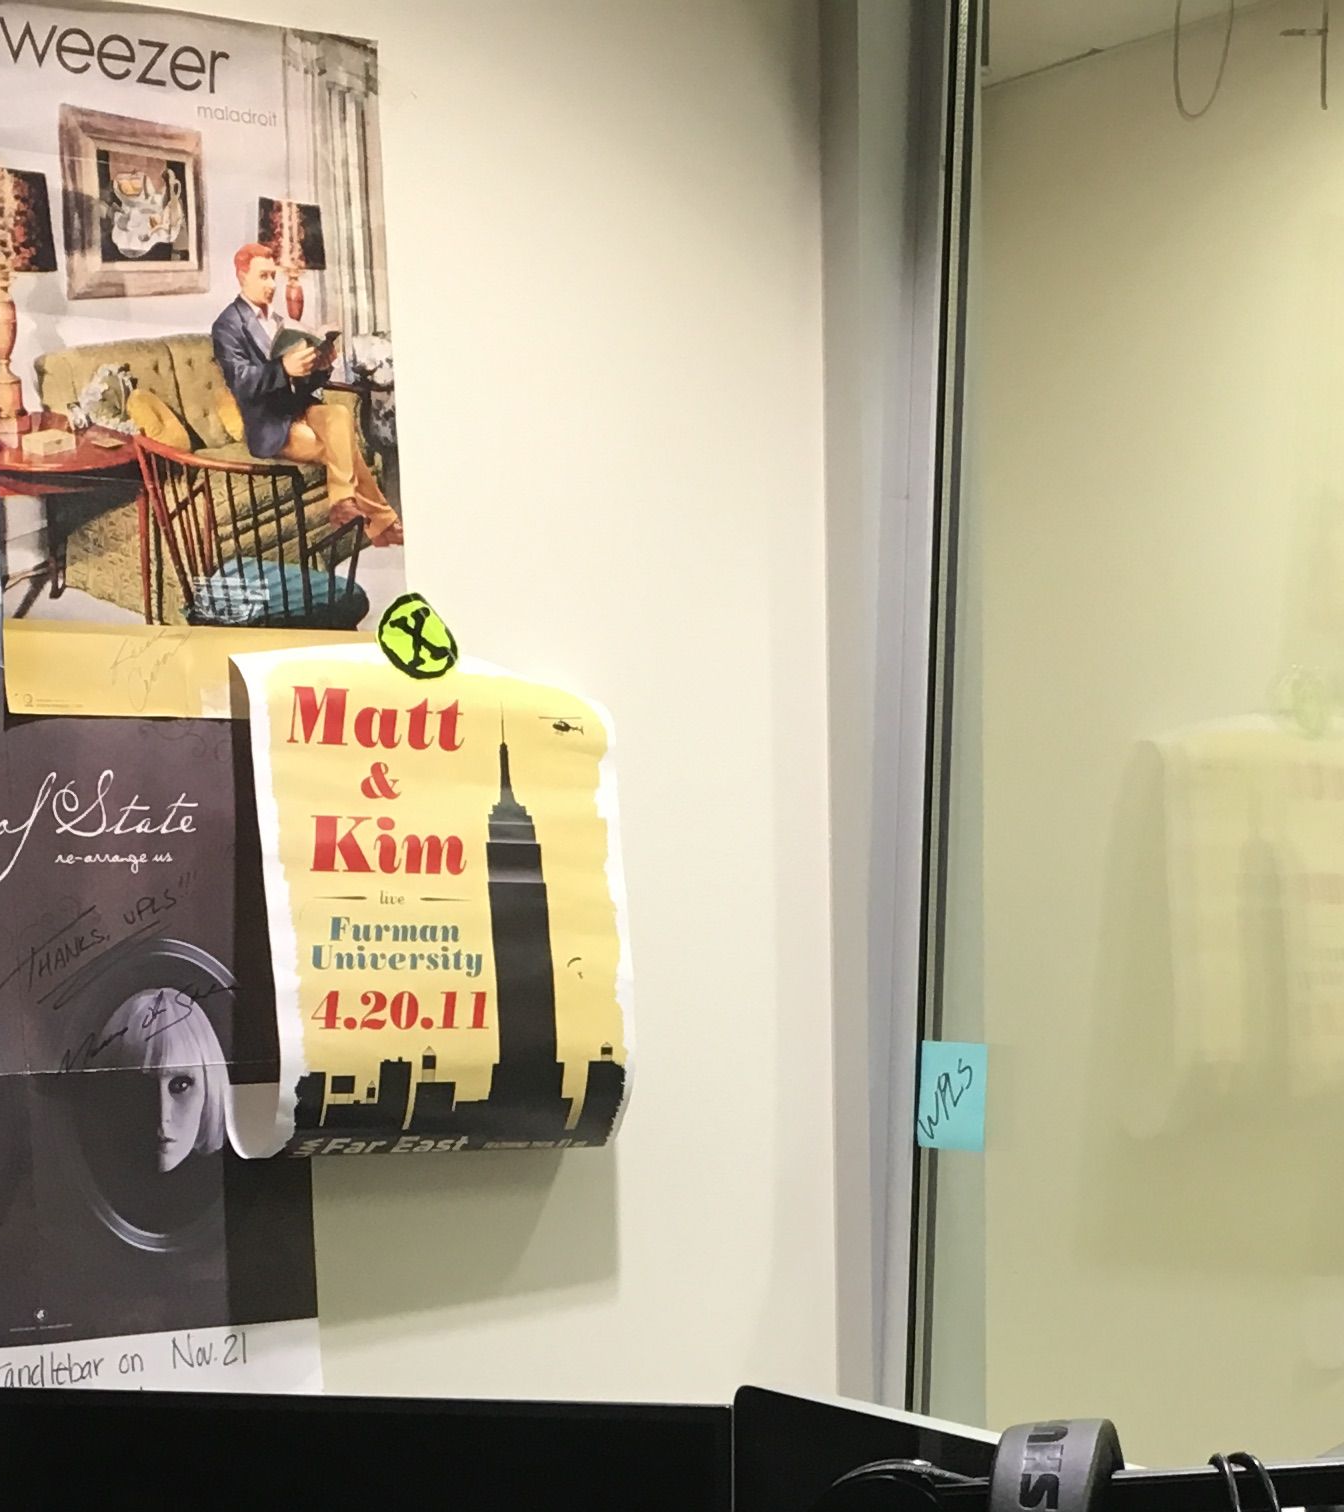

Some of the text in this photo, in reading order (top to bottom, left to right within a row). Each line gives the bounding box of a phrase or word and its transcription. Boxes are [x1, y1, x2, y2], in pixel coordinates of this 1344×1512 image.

[196, 102, 278, 128] maladroit
[286, 684, 465, 752] Matt
[360, 761, 402, 800] &
[52, 769, 199, 837] State
[309, 814, 467, 875] Kim
[55, 850, 174, 873] re-arrange us
[379, 890, 405, 906] live
[330, 916, 460, 943] Furman
[311, 945, 483, 978] University
[311, 990, 490, 1031] 4.20.11
[321, 1138, 386, 1156] Far
[390, 1135, 468, 1154] East
[118, 1352, 144, 1374] on
